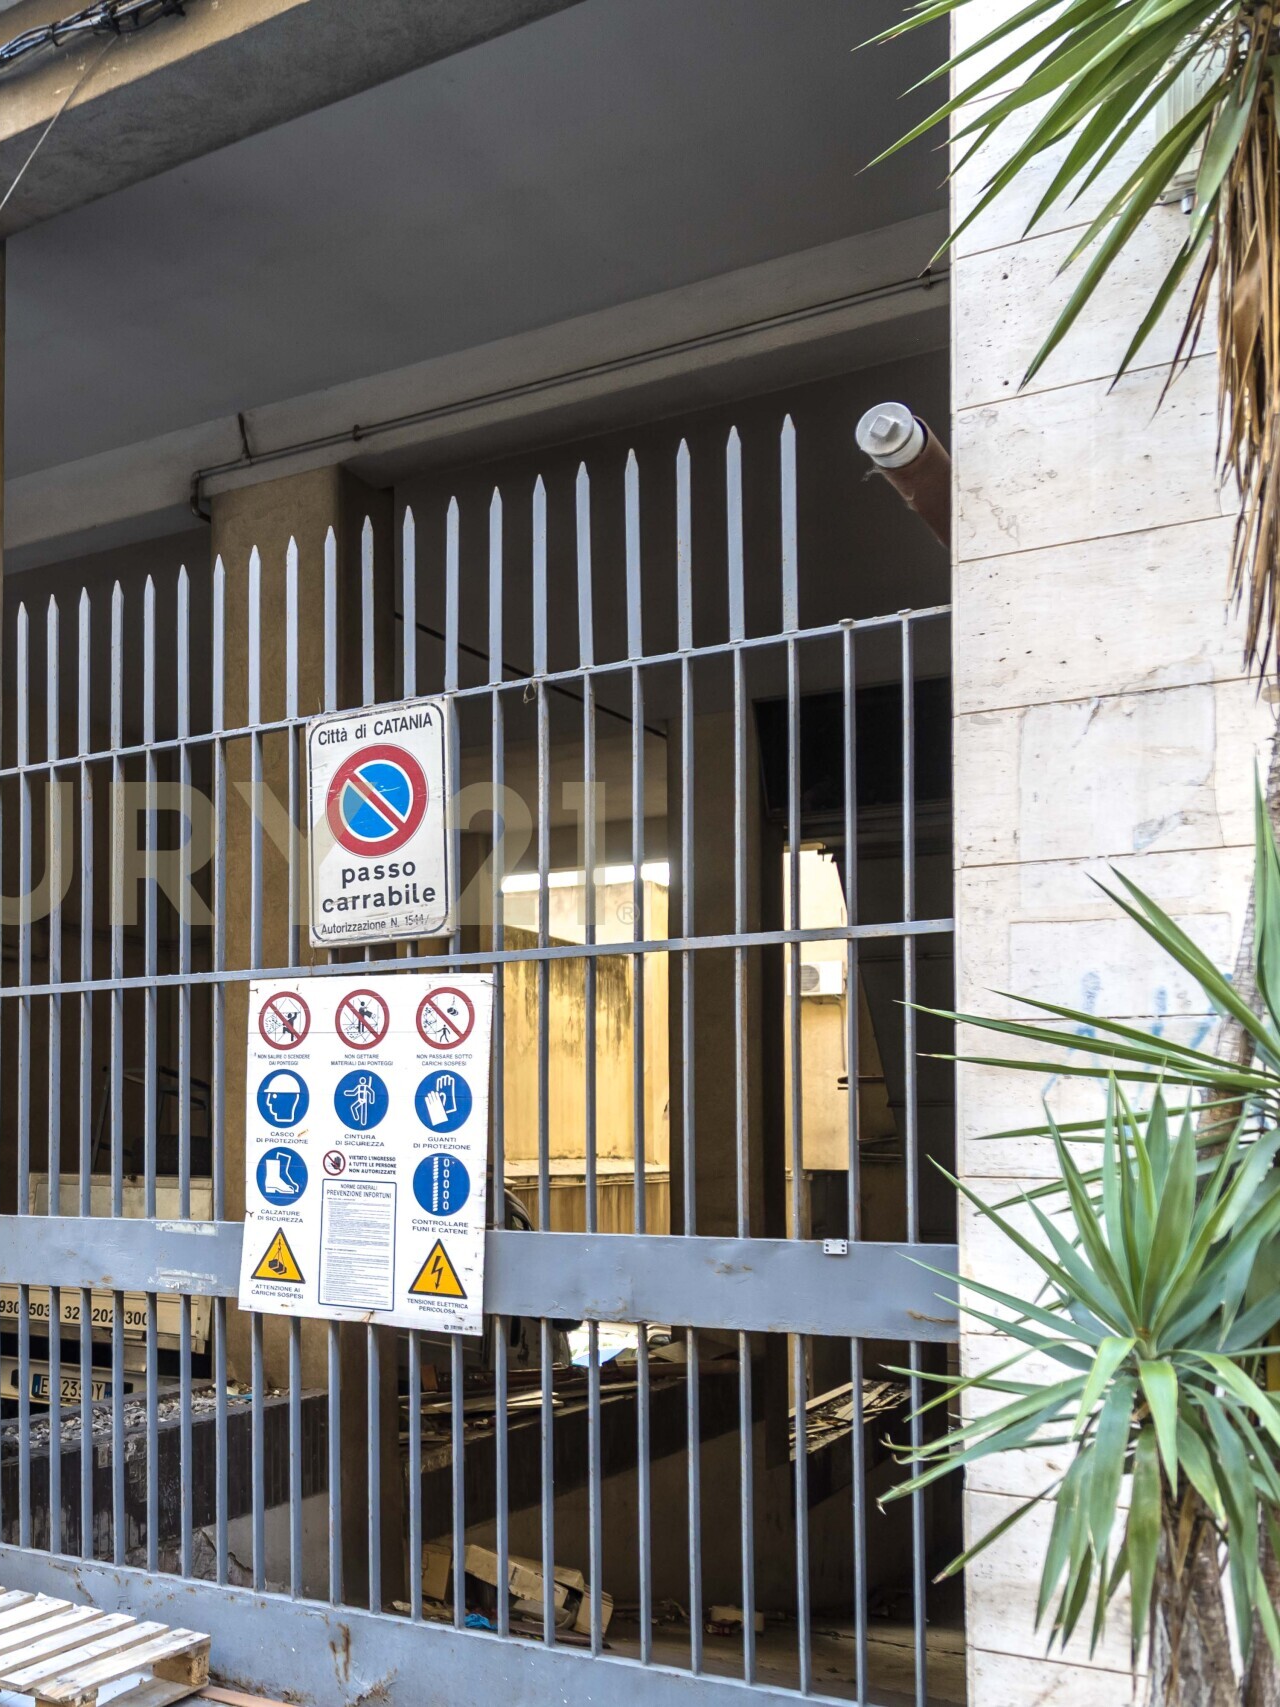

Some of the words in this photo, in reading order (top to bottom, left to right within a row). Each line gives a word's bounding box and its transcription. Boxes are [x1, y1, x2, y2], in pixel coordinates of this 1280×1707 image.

[318, 728, 348, 746] Città
[355, 724, 366, 739] di
[374, 712, 433, 736] CATANIA
[342, 861, 416, 889] passo
[322, 883, 436, 913] carrabile
[321, 920, 386, 935] Autorizzazione
[391, 917, 400, 928] N.
[327, 1189, 362, 1197] PREVENZIONE
[364, 1191, 392, 1199] INFORTUNI
[412, 1219, 469, 1228] CONTROLLARE
[255, 1284, 292, 1292] ATTENZIONE
[407, 1298, 435, 1306] TENSIONE
[419, 1306, 456, 1314] PERICOLOSA
